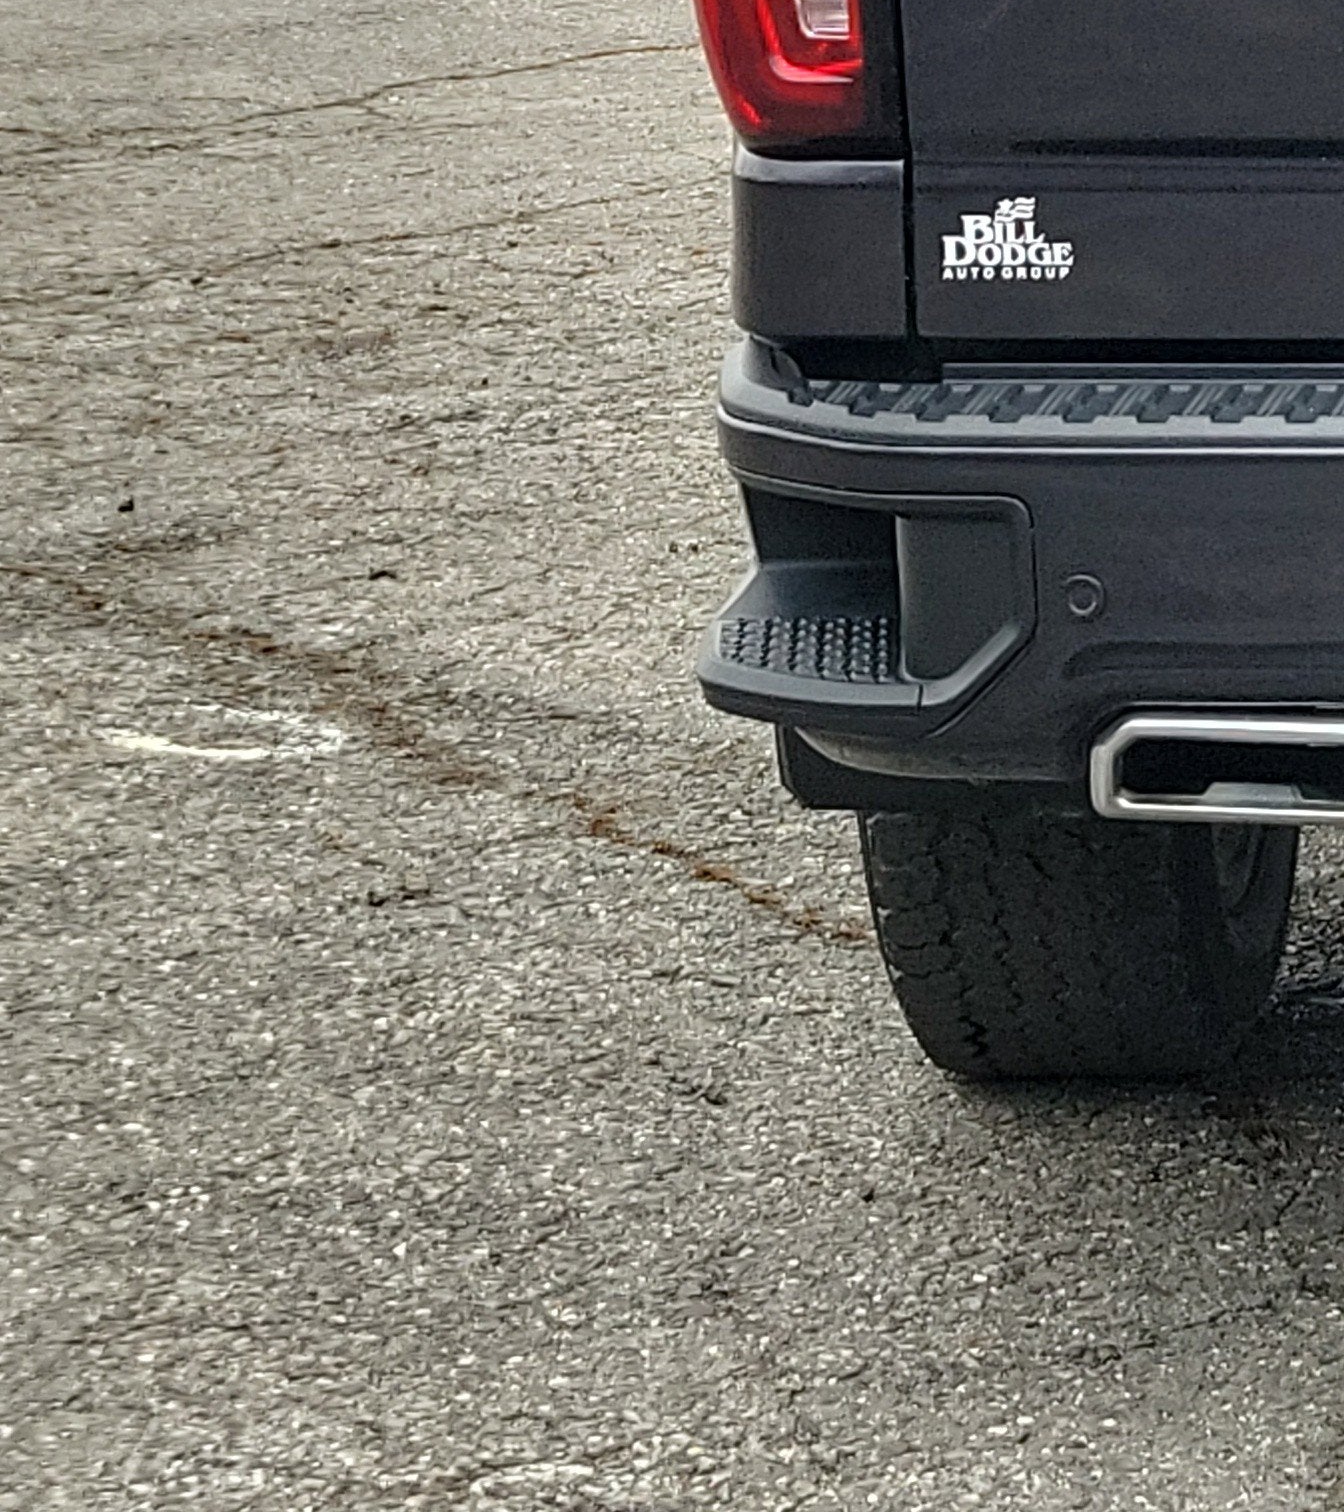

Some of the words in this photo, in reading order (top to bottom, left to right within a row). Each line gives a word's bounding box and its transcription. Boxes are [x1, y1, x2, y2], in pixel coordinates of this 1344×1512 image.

[960, 214, 1046, 245] BILL
[941, 235, 1075, 267] DODGE
[942, 266, 996, 281] AUTO
[1000, 266, 1071, 281] GROUP
